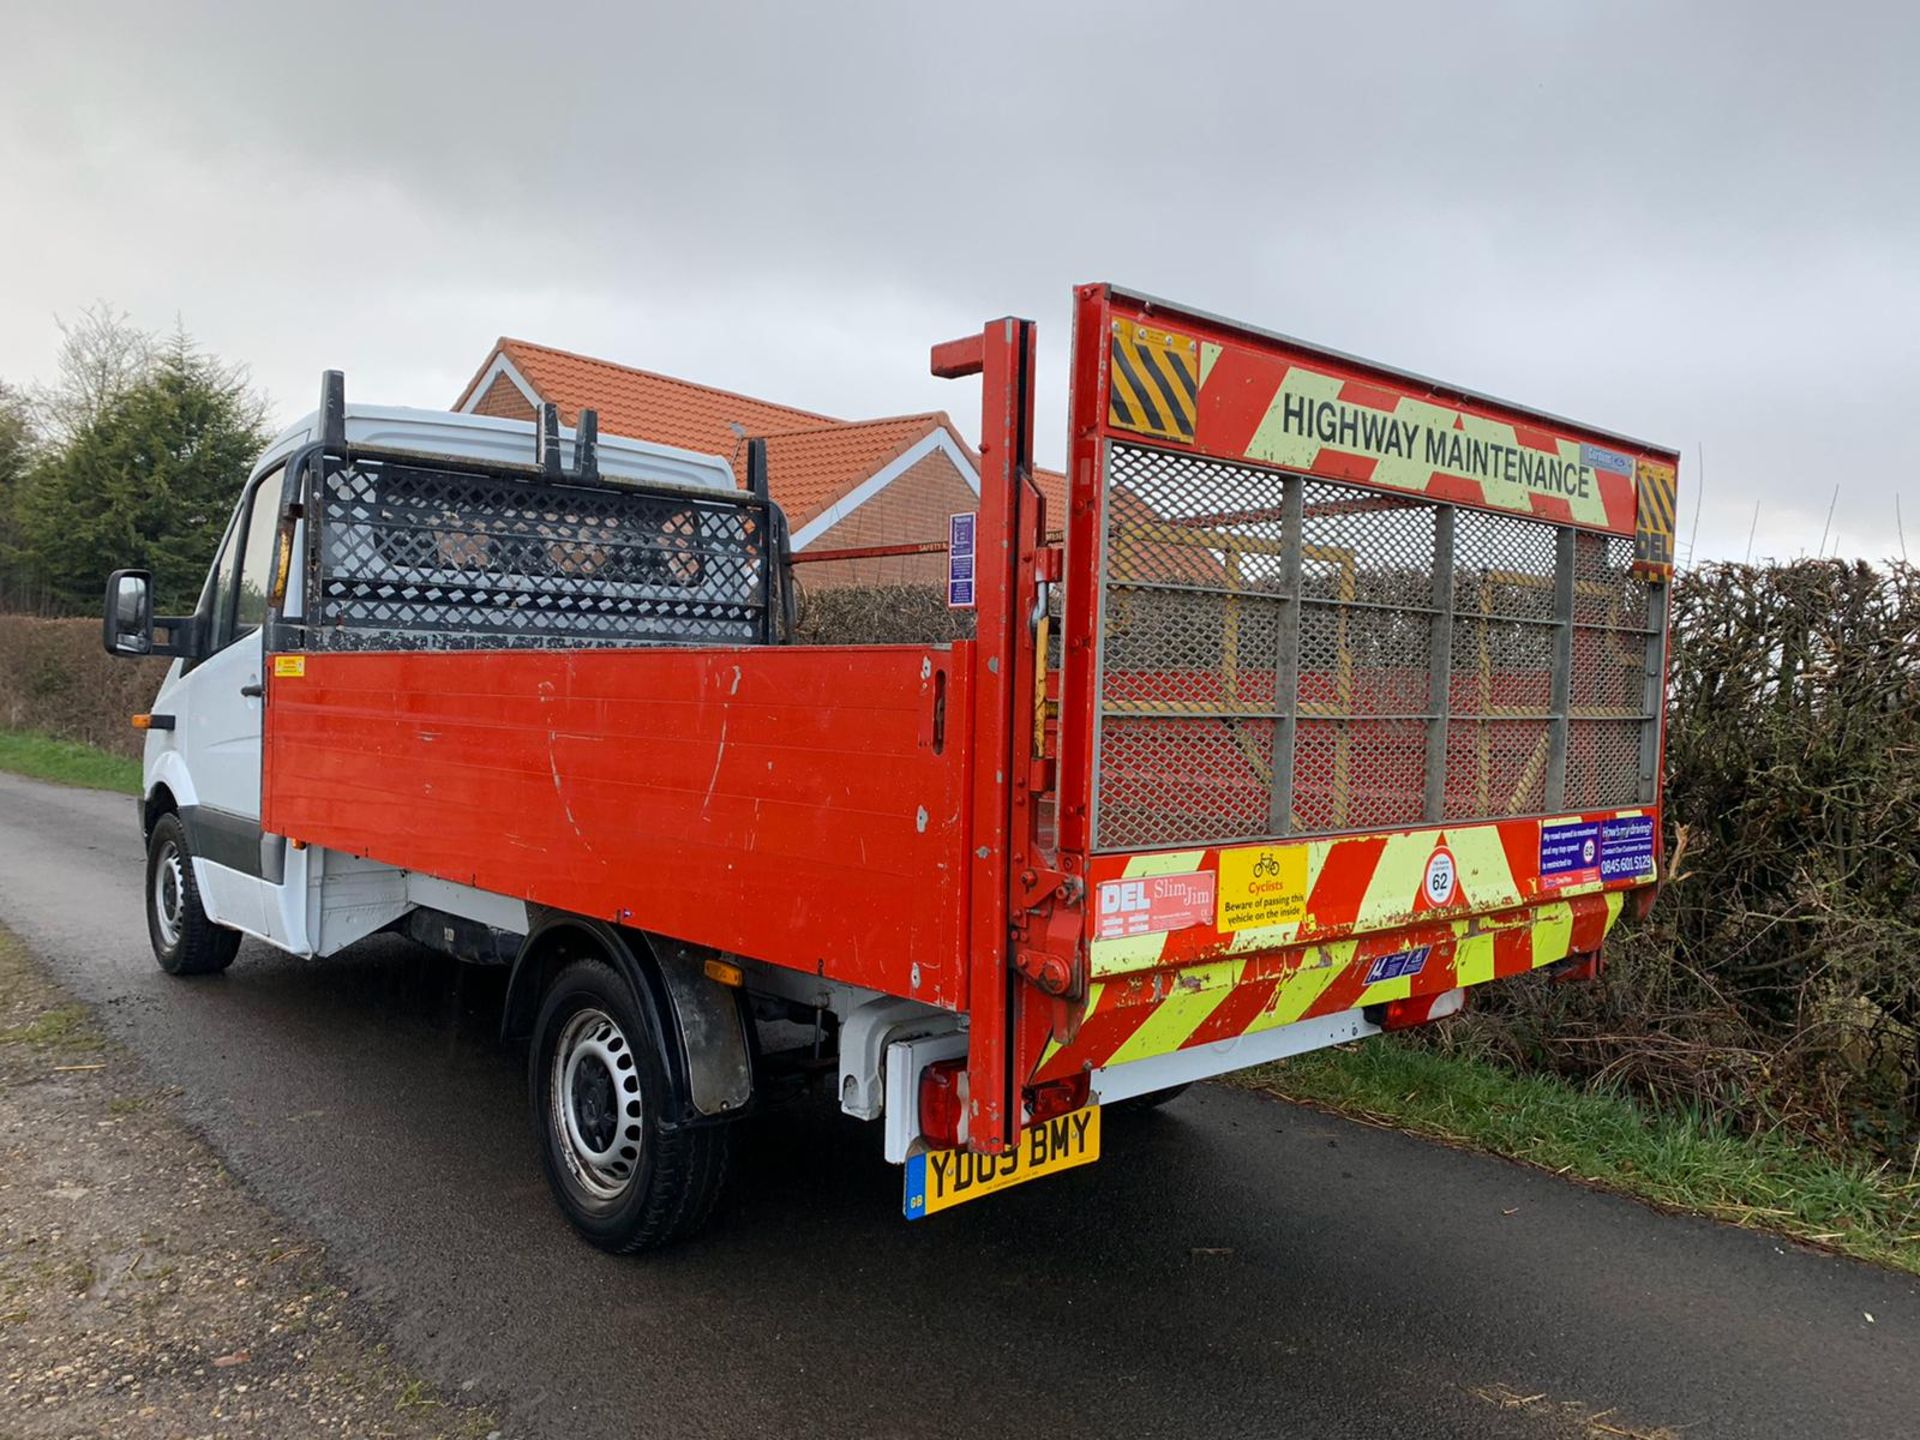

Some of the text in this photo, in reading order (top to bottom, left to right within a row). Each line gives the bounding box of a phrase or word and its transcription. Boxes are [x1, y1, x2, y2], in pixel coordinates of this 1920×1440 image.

[1282, 392, 1590, 499] HIGHWAY MAINTENANCE
[1550, 831, 1561, 840] road
[1620, 827, 1630, 838] my
[1630, 822, 1653, 836] driving?
[1542, 846, 1552, 855] and
[1567, 843, 1579, 854] speed
[1601, 858, 1620, 875] 0845
[1620, 857, 1634, 872] 601
[1634, 855, 1651, 871] 5129
[1248, 880, 1284, 896] Cyclists
[1432, 872, 1448, 891] 62
[1101, 878, 1187, 914] DEL Slim
[1184, 887, 1209, 906] Jim
[1225, 893, 1304, 912] Beware of passing this
[1227, 906, 1300, 927] vehicle on the inside
[1028, 1110, 1092, 1168] BMY
[910, 1194, 923, 1209] GB
